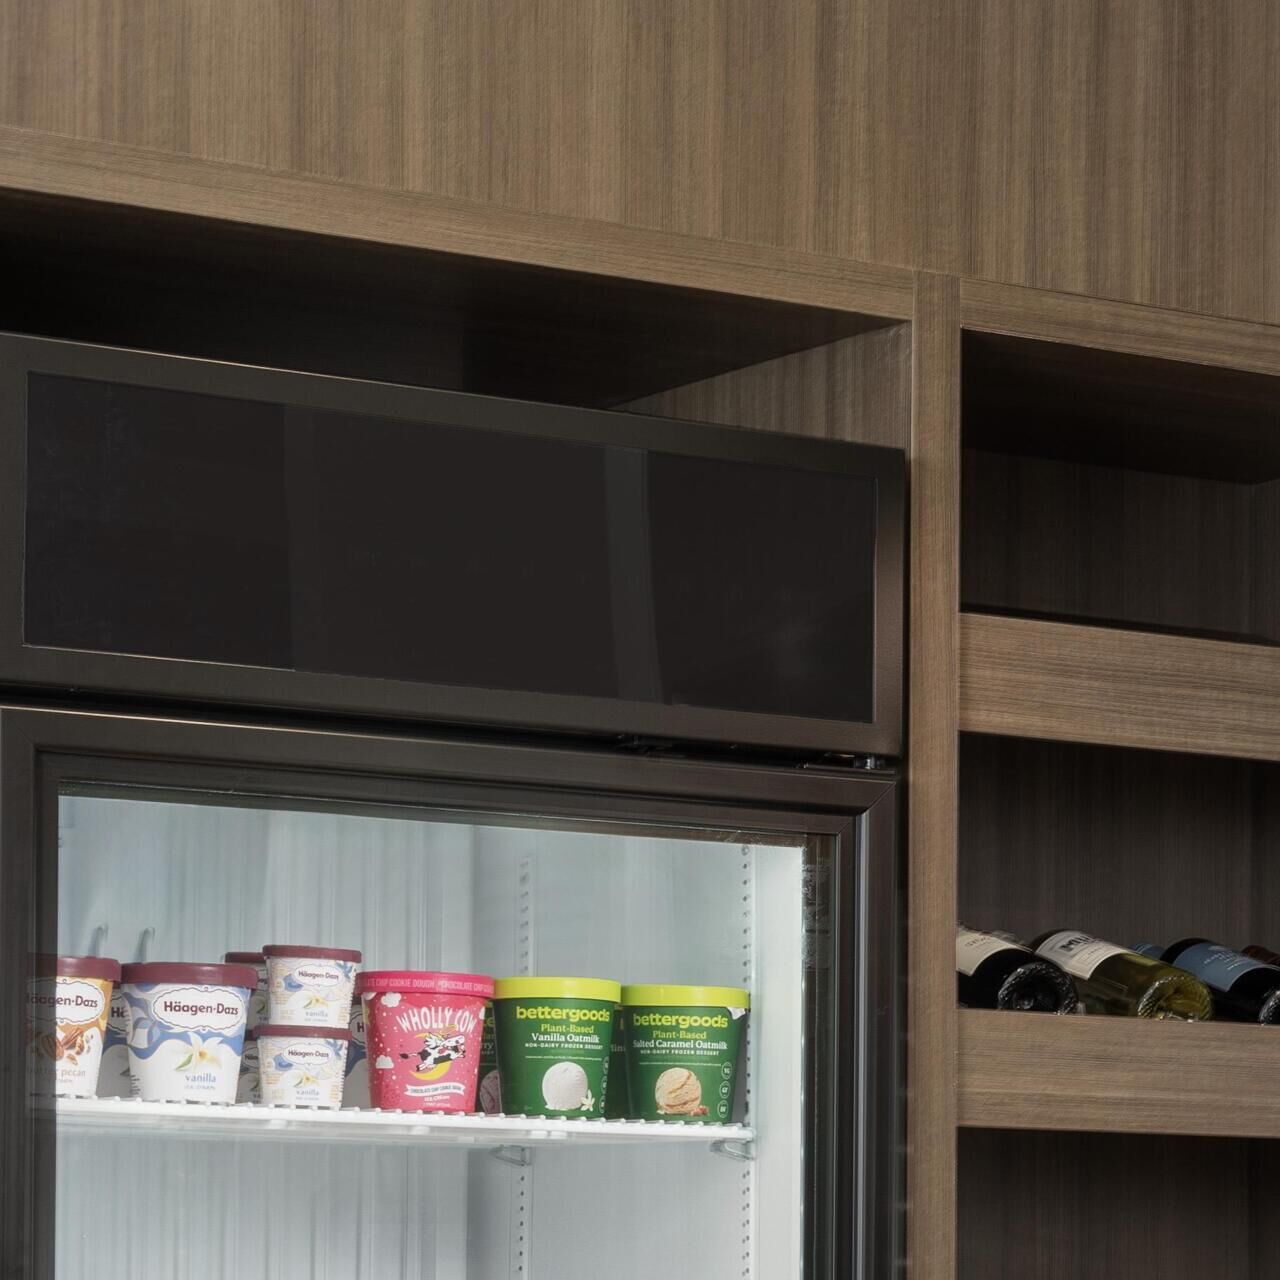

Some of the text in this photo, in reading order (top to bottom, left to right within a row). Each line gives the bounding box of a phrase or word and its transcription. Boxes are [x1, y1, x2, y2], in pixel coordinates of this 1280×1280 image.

[516, 1006, 610, 1022] bettergoods
[396, 1007, 477, 1033] WHOLLY COW
[633, 1013, 728, 1028] bettergoods
[540, 1023, 594, 1034] Plant-Based
[652, 1029, 707, 1039] Plant-Based
[532, 1033, 600, 1043] Vanilla Oatmilk
[654, 1039, 685, 1048] Caramel
[687, 1040, 728, 1050] Oatmilk
[185, 1073, 216, 1084] vanilla
